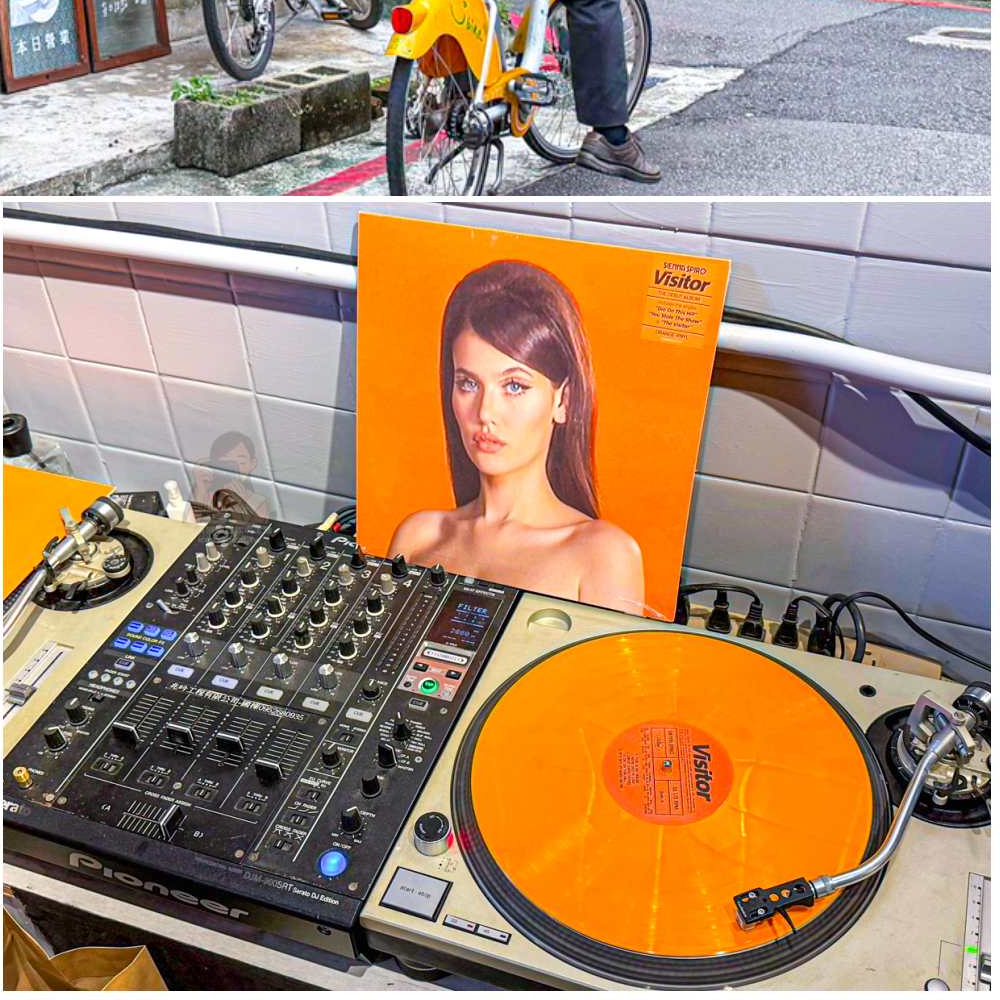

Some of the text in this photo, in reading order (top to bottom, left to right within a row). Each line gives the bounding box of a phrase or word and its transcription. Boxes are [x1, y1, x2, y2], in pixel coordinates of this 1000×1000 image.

[16, 29, 71, 56] 本日營業
[654, 269, 711, 292] Visitor
[319, 561, 331, 570] 2
[361, 570, 372, 578] 3
[403, 579, 413, 588] 4
[456, 603, 489, 614] FILTER
[692, 745, 713, 802] Visitor
[69, 853, 249, 919] Pioneer
[293, 887, 311, 897] Serato
[311, 892, 319, 900] DJ
[320, 894, 339, 905] Edition
